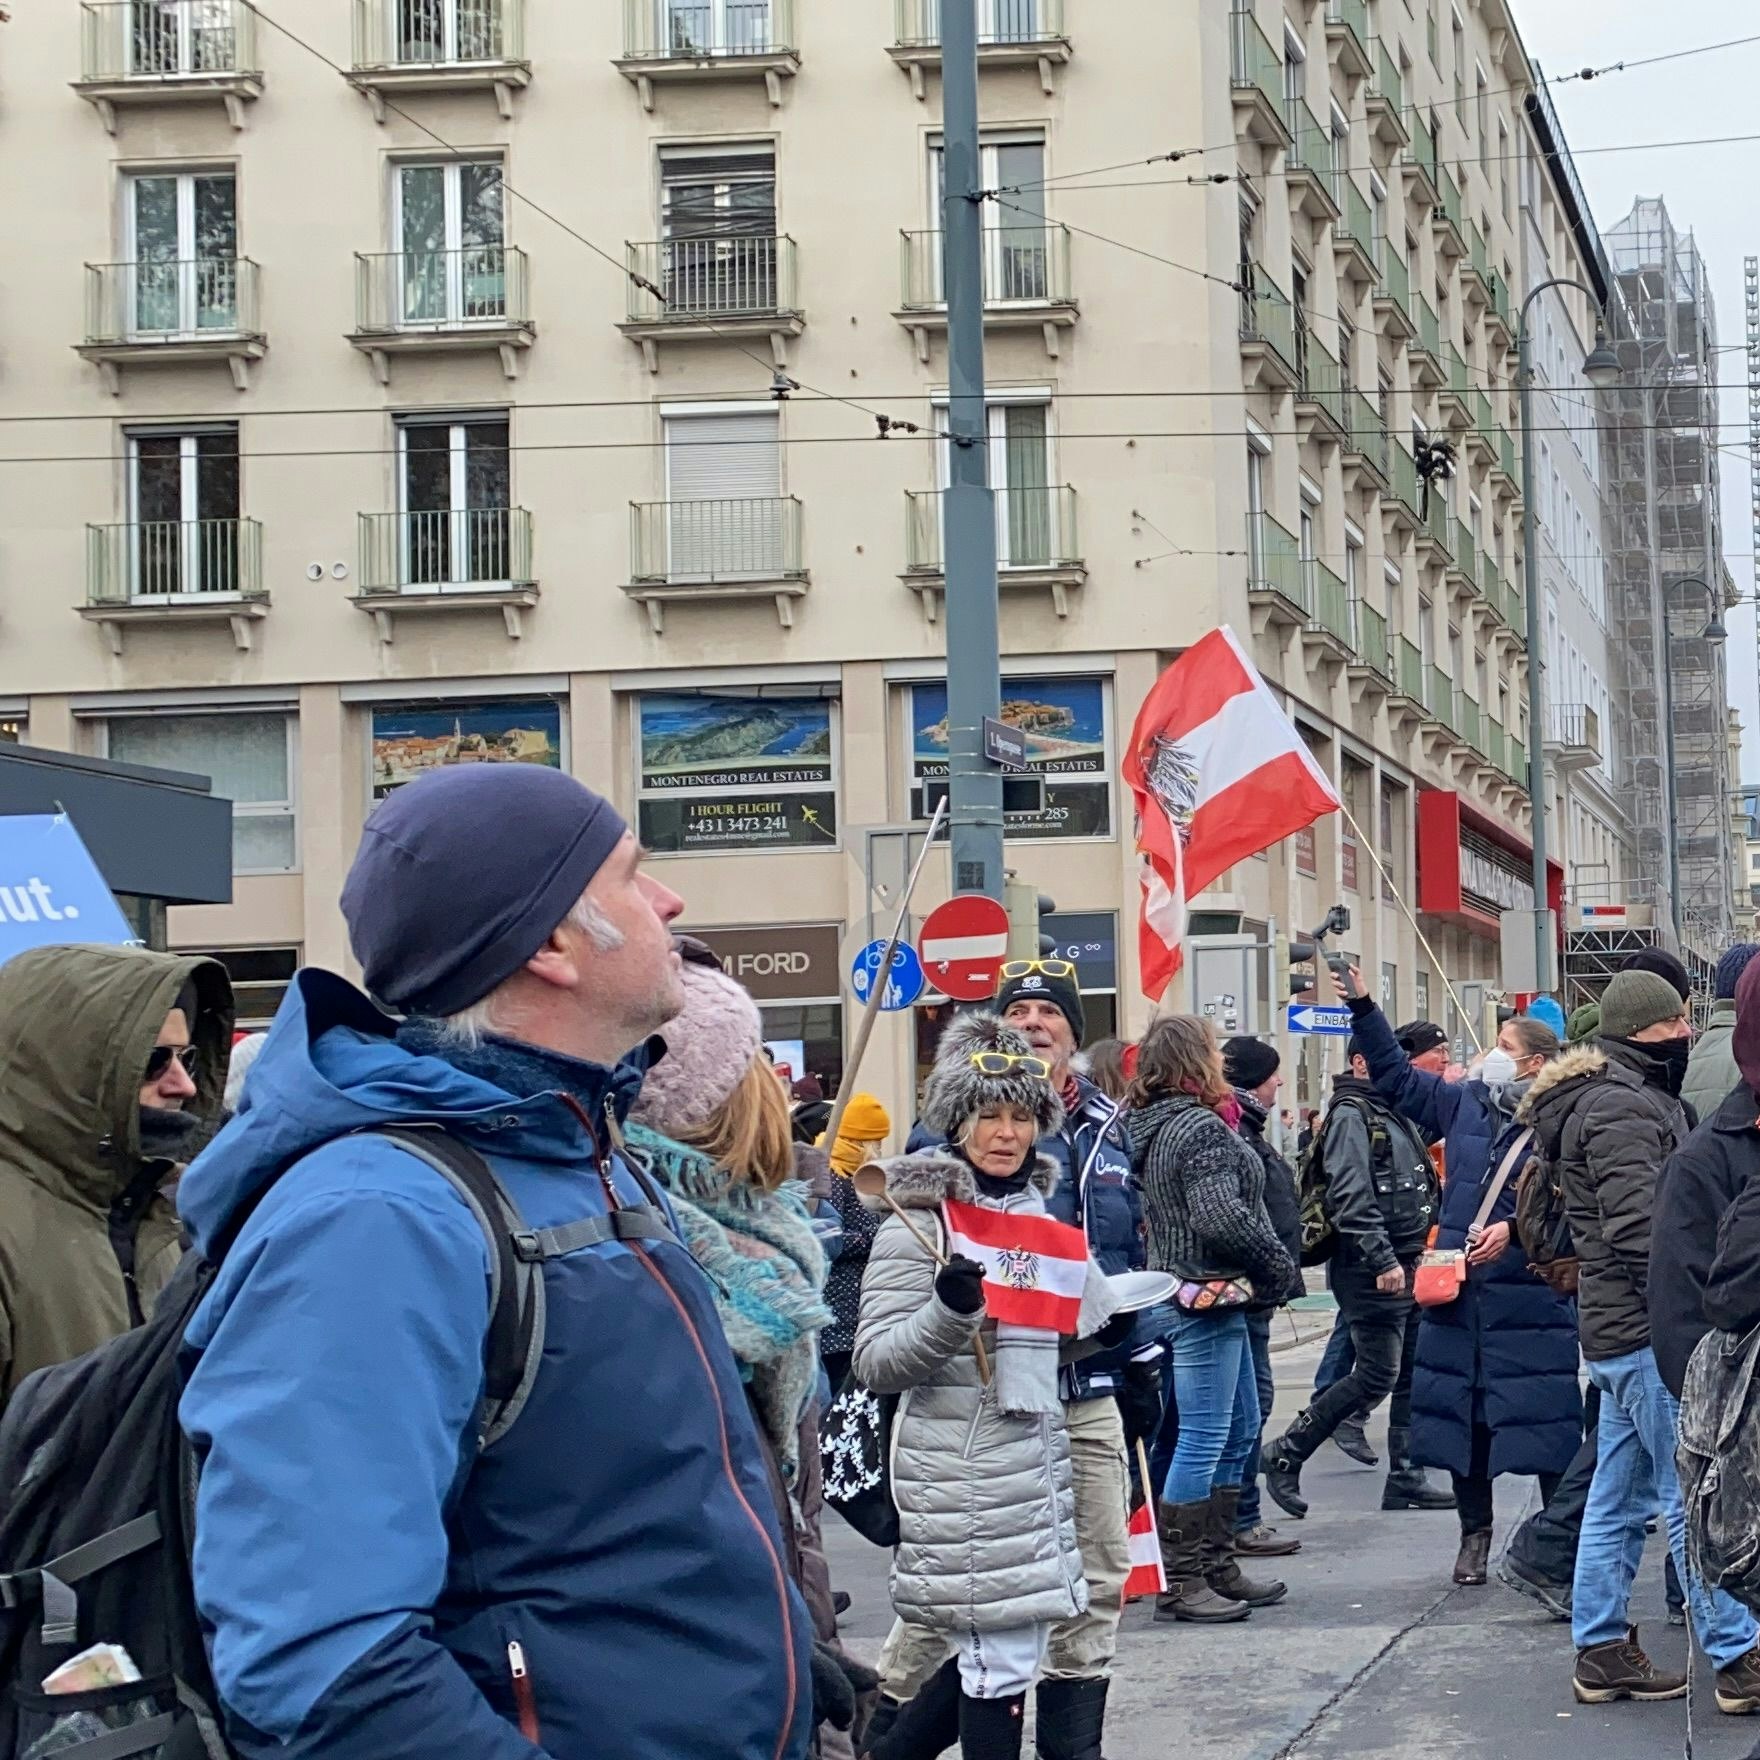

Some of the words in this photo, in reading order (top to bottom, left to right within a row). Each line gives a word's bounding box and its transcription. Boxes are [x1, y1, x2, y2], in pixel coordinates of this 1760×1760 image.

[1046, 760, 1097, 772] ESTATES
[650, 773, 737, 788] MONTENEGRO
[739, 771, 771, 784] REAL
[773, 769, 823, 782] ESTATES
[697, 804, 734, 816] HOUR
[737, 802, 783, 815] FLIGHT
[1044, 808, 1069, 820] 285
[687, 818, 713, 833] +43
[716, 818, 723, 832] 1
[728, 817, 760, 832] 3473
[765, 816, 787, 830] 241
[0, 877, 79, 922] ut.
[737, 951, 810, 975] FORD
